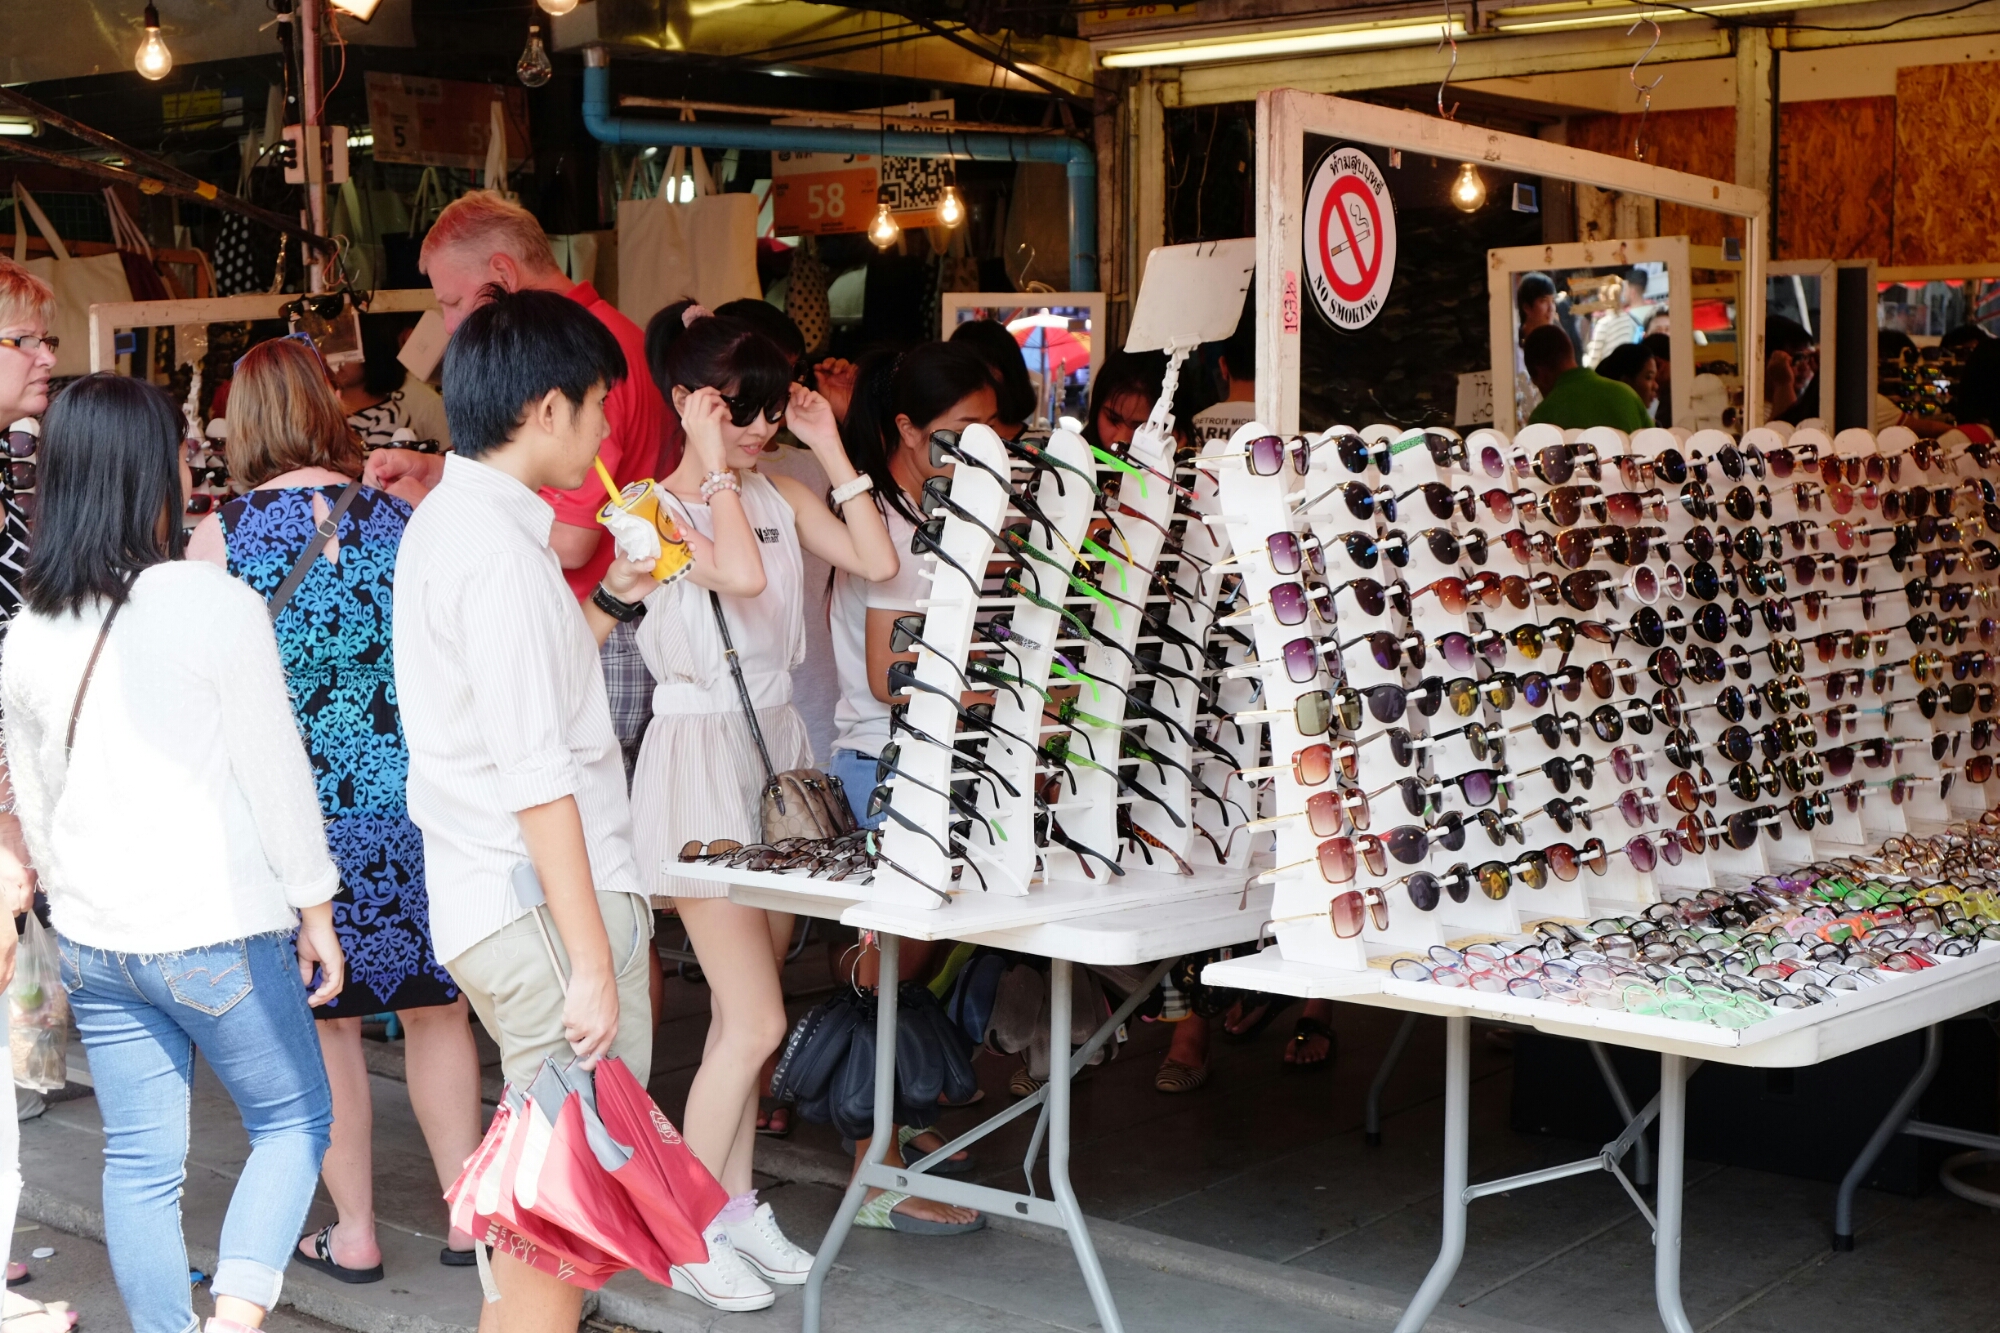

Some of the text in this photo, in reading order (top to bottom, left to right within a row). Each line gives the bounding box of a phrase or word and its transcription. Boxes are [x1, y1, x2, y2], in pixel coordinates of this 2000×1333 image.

[468, 121, 492, 151] 5
[808, 182, 846, 220] 58
[1314, 274, 1379, 324] NO SMOKING
[1194, 417, 1229, 425] DETROIT
